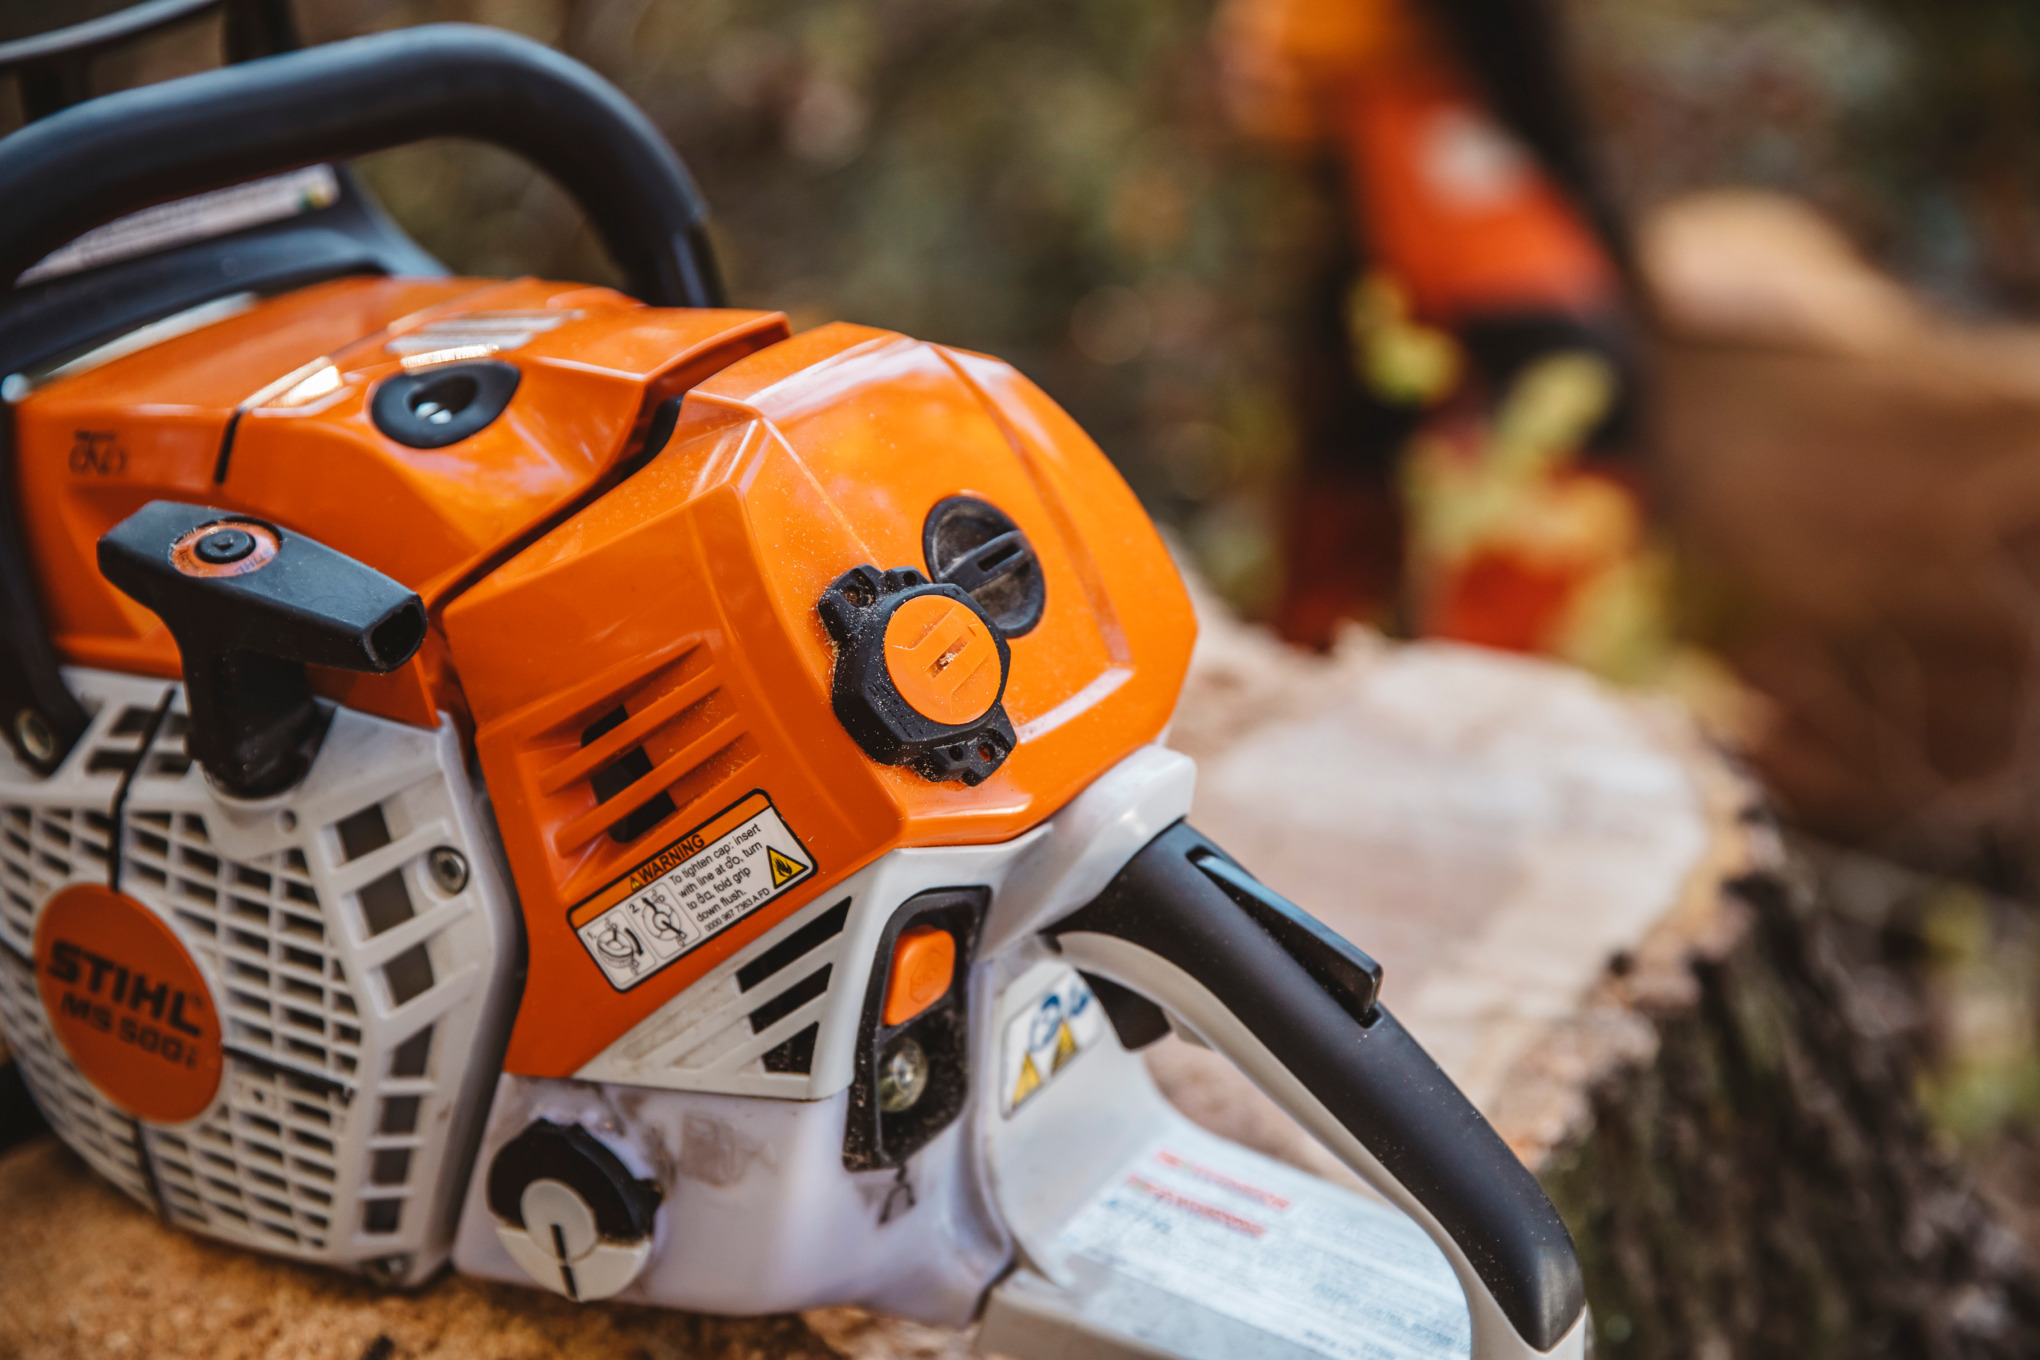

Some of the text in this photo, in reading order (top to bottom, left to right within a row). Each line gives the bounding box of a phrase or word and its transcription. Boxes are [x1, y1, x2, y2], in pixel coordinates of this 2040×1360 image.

[638, 834, 706, 883] WARNING
[669, 823, 761, 885] To tighten cap: insert
[679, 841, 762, 899] with line at turn
[687, 866, 752, 910] to fold grip
[696, 891, 747, 922] down flush.
[704, 918, 722, 932] 0000
[47, 938, 201, 1038] STIHL
[60, 991, 113, 1033] MS
